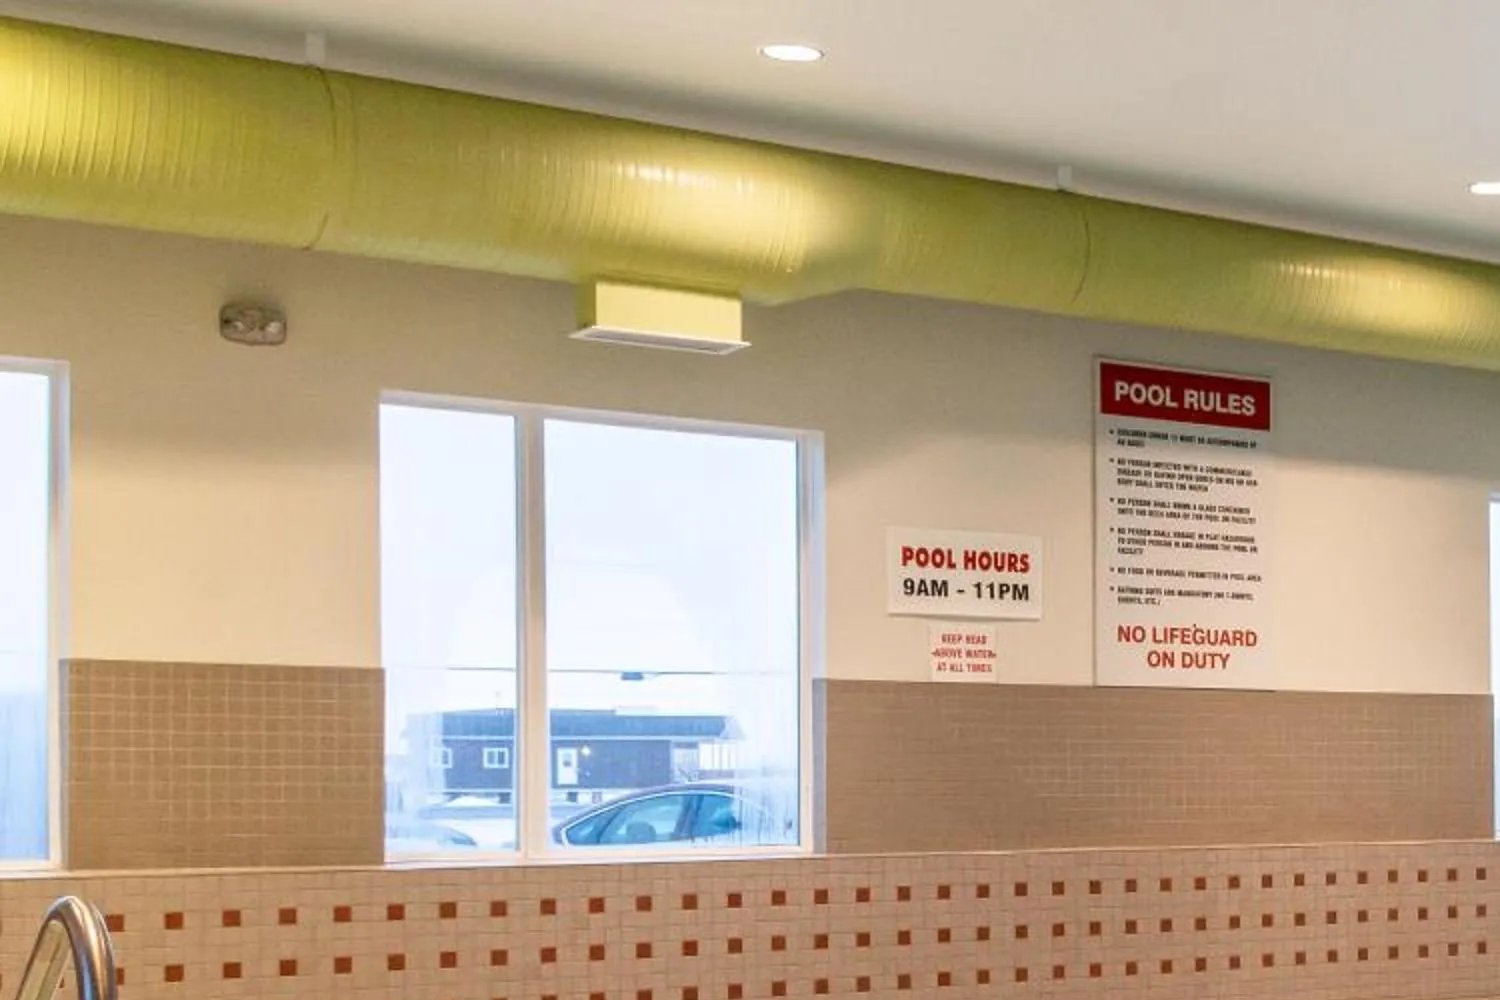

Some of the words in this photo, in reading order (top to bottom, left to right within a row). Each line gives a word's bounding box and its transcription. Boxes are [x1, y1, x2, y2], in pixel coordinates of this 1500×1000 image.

[1114, 381, 1178, 408] POOL
[1184, 389, 1256, 416] RULES
[901, 546, 956, 569] POOL
[963, 550, 1030, 573] HOURS
[903, 578, 949, 597] 9AM
[973, 582, 1029, 601] 11PM
[1117, 625, 1146, 643] NO
[1152, 627, 1257, 646] LIFEGUARD
[1147, 650, 1175, 668] ON
[1181, 652, 1231, 669] DUTY
